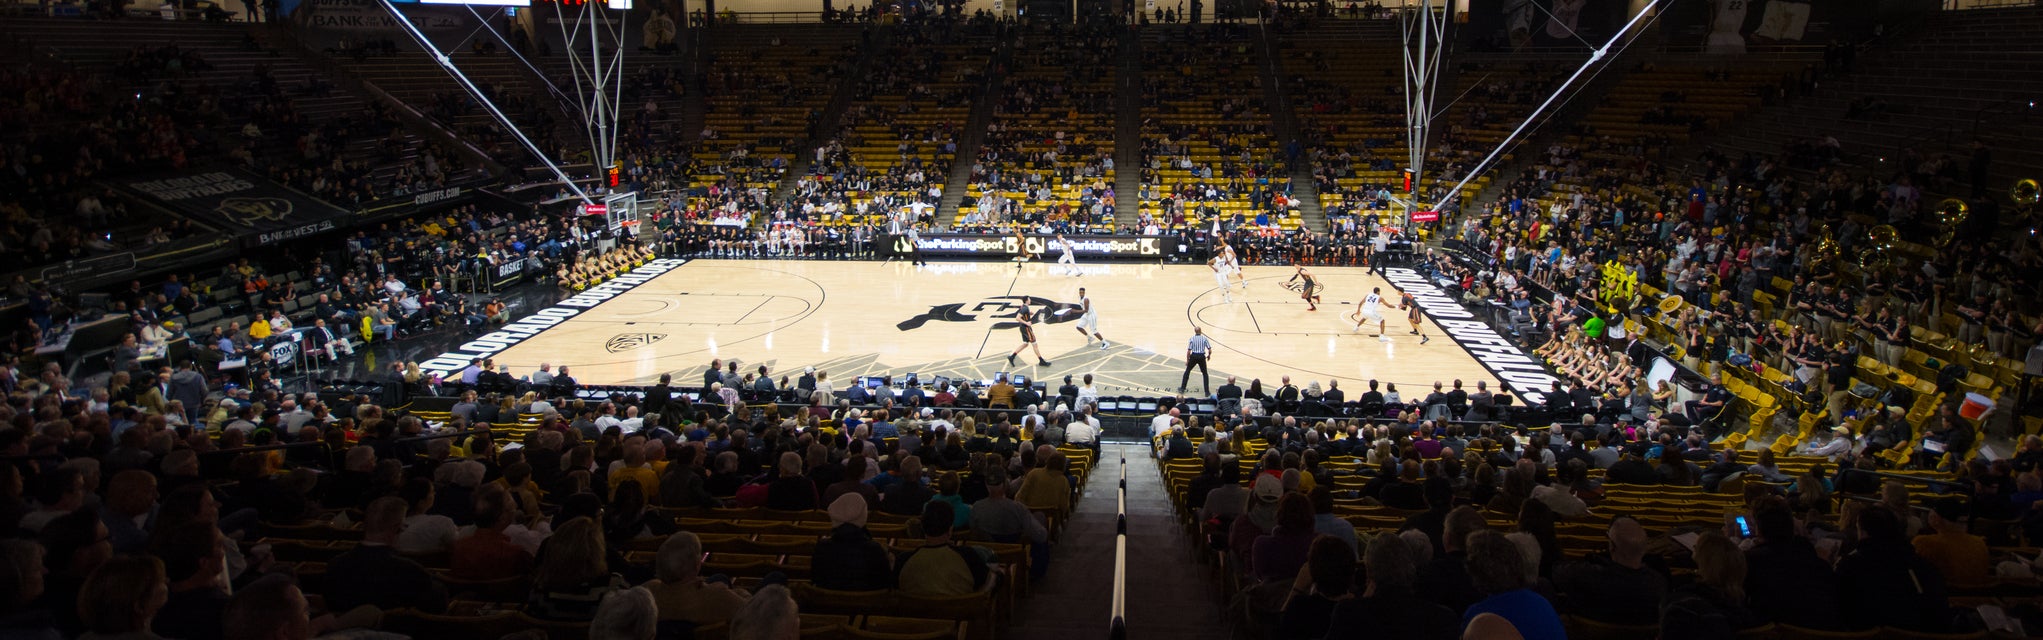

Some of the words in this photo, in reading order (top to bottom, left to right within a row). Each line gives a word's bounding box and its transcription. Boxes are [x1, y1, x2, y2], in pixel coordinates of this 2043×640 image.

[314, 15, 362, 26] BANK
[380, 16, 431, 27] WST
[415, 187, 461, 205] CUBUFFS.COM
[259, 231, 284, 244] BNK
[918, 238, 1004, 252] theParkingSpot
[1047, 238, 1139, 254] thParkingSpot
[499, 260, 524, 278] BASKET
[1367, 296, 1378, 304] 24
[273, 344, 292, 357] FOX
